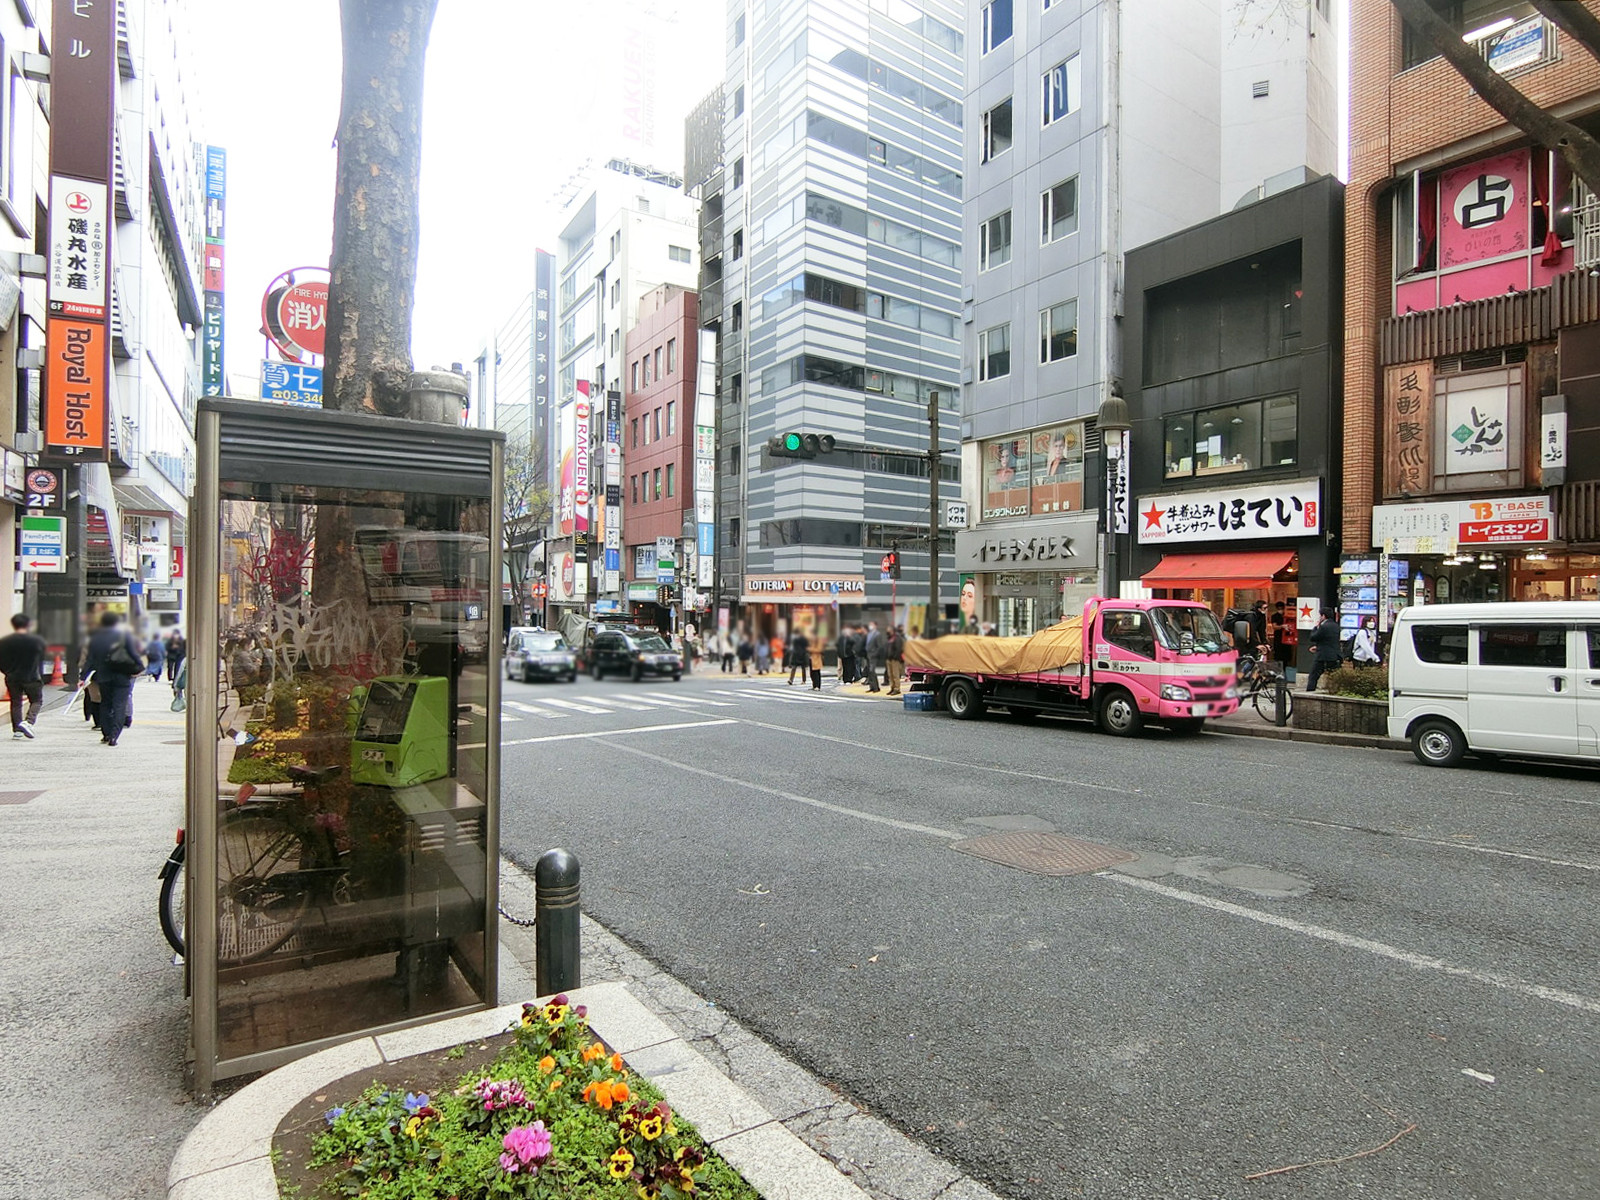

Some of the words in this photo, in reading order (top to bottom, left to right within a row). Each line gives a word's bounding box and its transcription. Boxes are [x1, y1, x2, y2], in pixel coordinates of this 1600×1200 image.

[209, 153, 224, 169] THE
[209, 169, 224, 197] PRIME
[1462, 174, 1512, 229] 占
[67, 218, 89, 291] 磯丸水産
[294, 288, 312, 298] FIRE
[50, 302, 64, 311] 6F
[62, 328, 92, 385] Royal
[536, 288, 548, 427] 渋東シネタワー
[66, 392, 91, 440] Host
[65, 447, 84, 455] 3F
[577, 424, 588, 486] RAKUEN
[28, 494, 56, 507] 2F
[948, 507, 965, 516] イワキ
[984, 504, 1027, 518] コンタクトレンズ
[1166, 504, 1216, 521] 牛煮込み
[1218, 496, 1303, 531] ほてい
[1305, 504, 1315, 527] ちゃん
[948, 515, 965, 524] メガネ
[1166, 520, 1216, 534] レモンサワー
[24, 532, 60, 541] FamilyMart
[1141, 531, 1167, 539] SAPPORO
[748, 580, 787, 591] LOTTERIA
[803, 580, 864, 592] LOTTERIA
